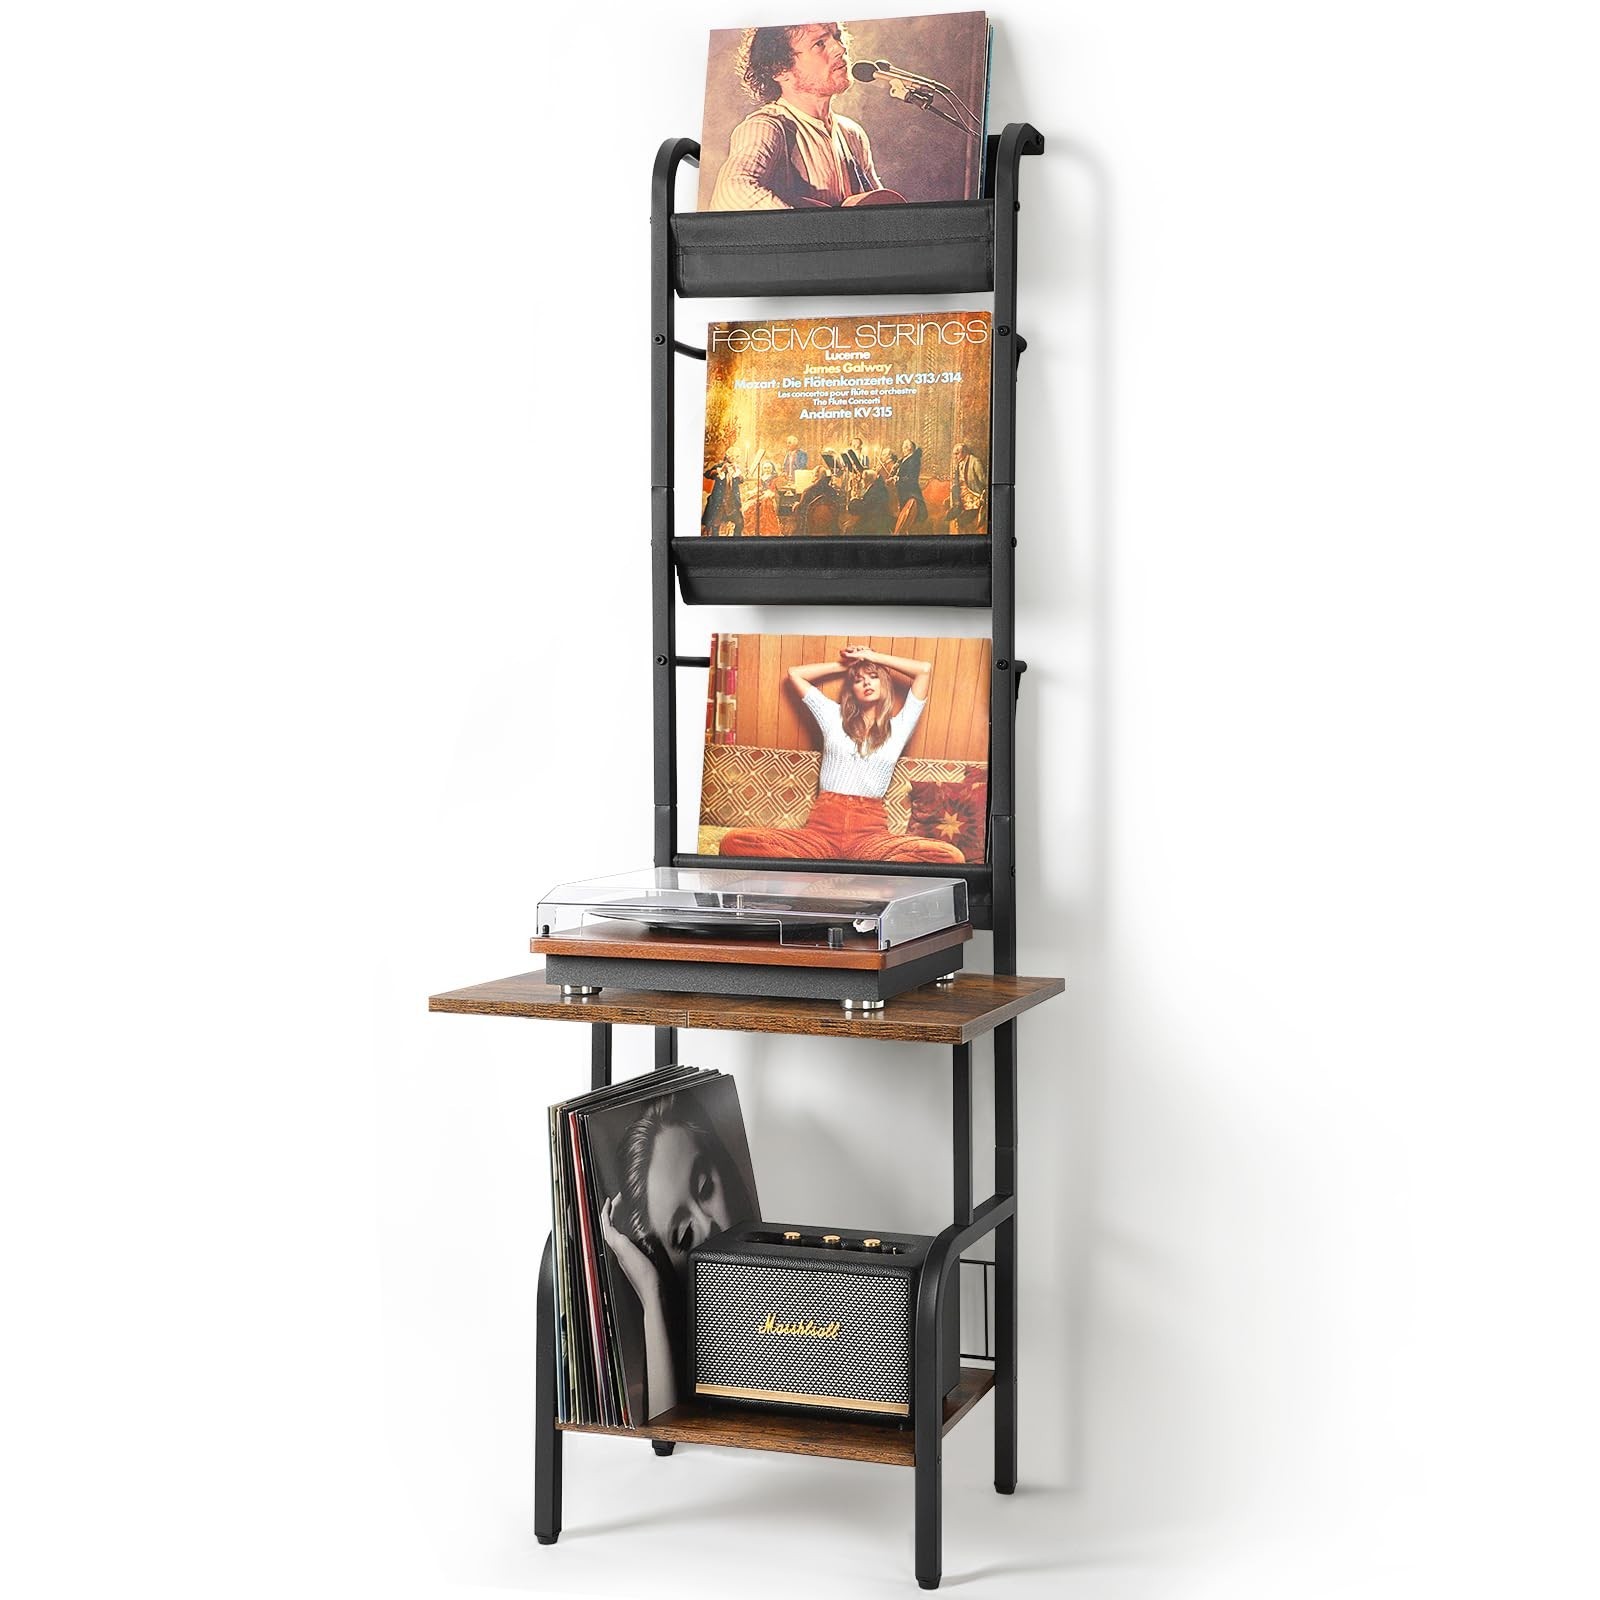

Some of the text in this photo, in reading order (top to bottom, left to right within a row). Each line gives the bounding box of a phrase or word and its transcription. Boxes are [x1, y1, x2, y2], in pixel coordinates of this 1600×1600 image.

[825, 350, 871, 361] Lucerne
[803, 362, 892, 374] James Galway
[782, 378, 802, 388] Die
[804, 375, 894, 387] Flötenkonzerte
[791, 390, 828, 398] concertos
[829, 390, 850, 398] pour
[879, 387, 917, 395] orchestre
[828, 398, 847, 406] Flute
[800, 408, 852, 420] Andante
